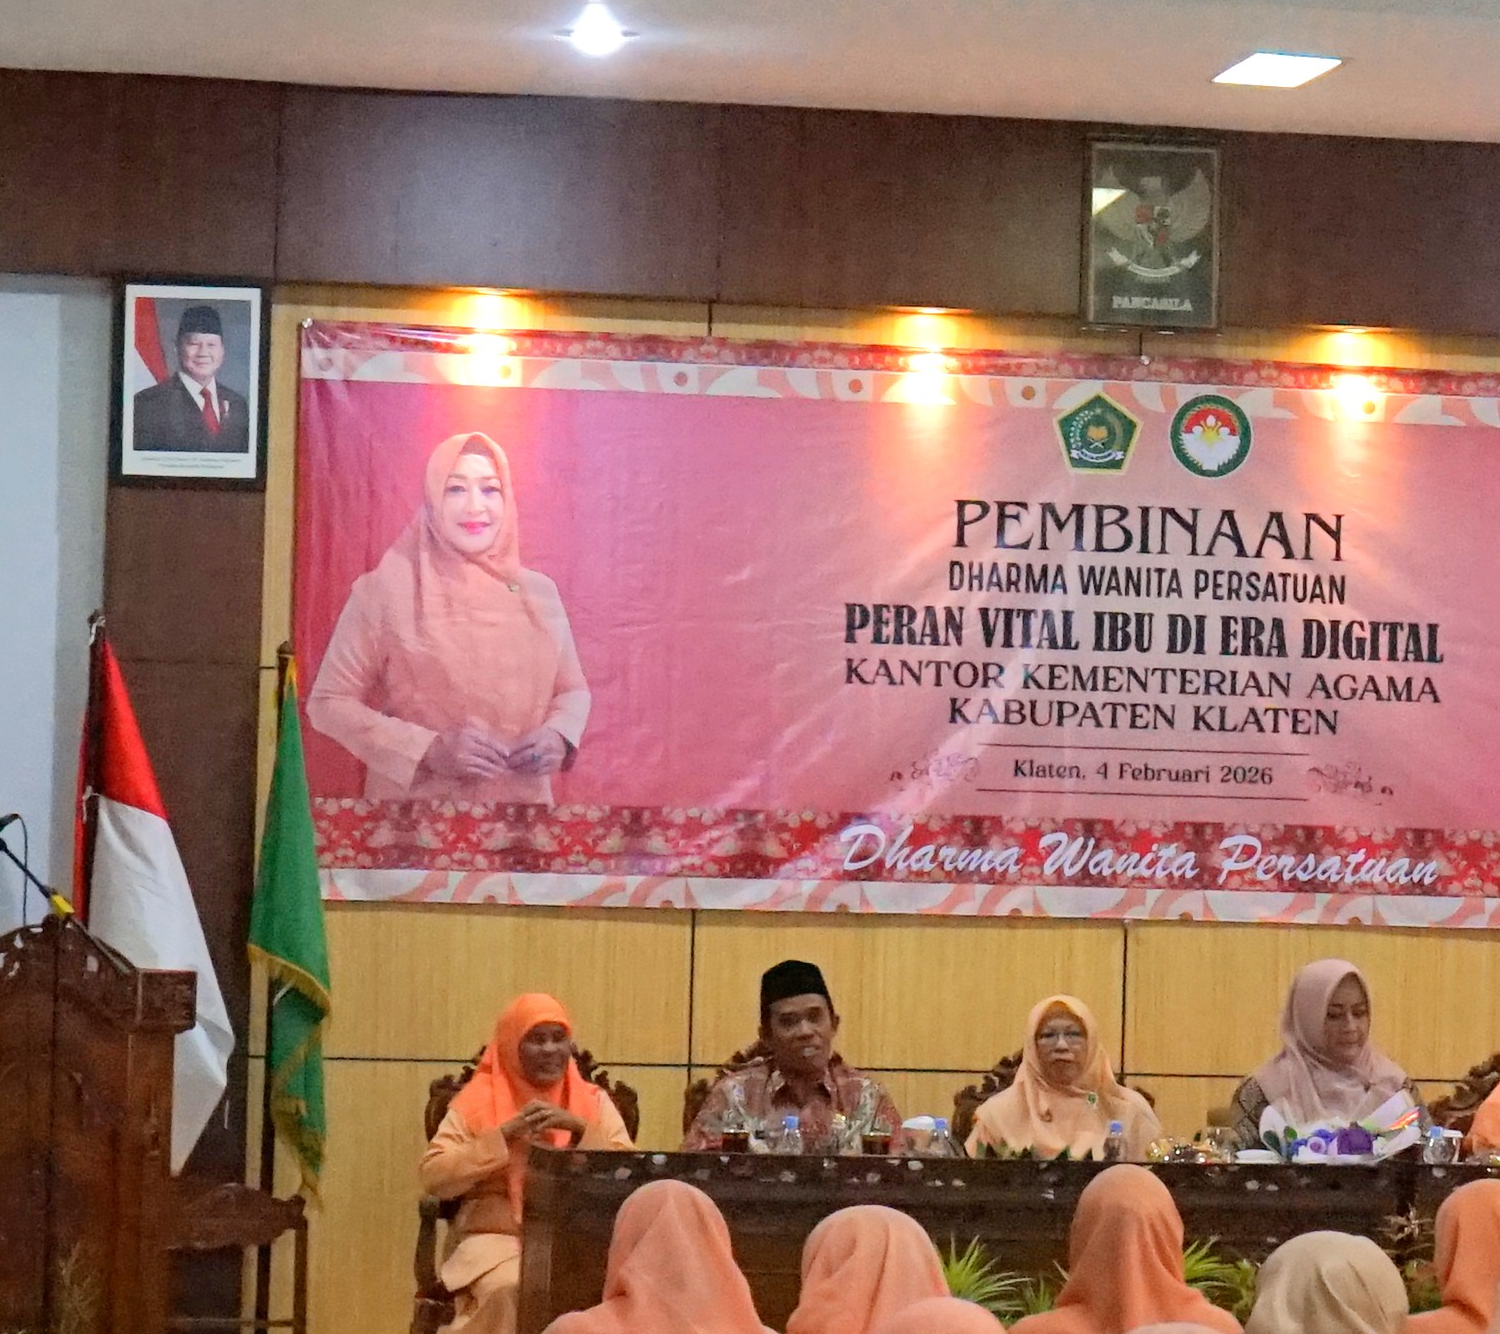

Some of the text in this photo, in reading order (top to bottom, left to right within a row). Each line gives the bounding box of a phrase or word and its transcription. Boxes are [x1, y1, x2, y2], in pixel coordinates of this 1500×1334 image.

[952, 499, 1345, 562] PEMBINAAN
[949, 560, 1346, 605] DHARMA WANITA PERSATUAN
[844, 602, 1444, 664] PERAN VITAL IBU DI ERA DIGITAL
[844, 657, 1441, 704] KANTOR KEMENTERIAN AGAMA
[948, 697, 1339, 736] KABUPATEN KLATEN
[1095, 762, 1109, 780] 4
[1118, 763, 1211, 784] Februari
[1219, 765, 1274, 785] 2026
[840, 823, 1440, 886] Dharma Wanita Persatuan
